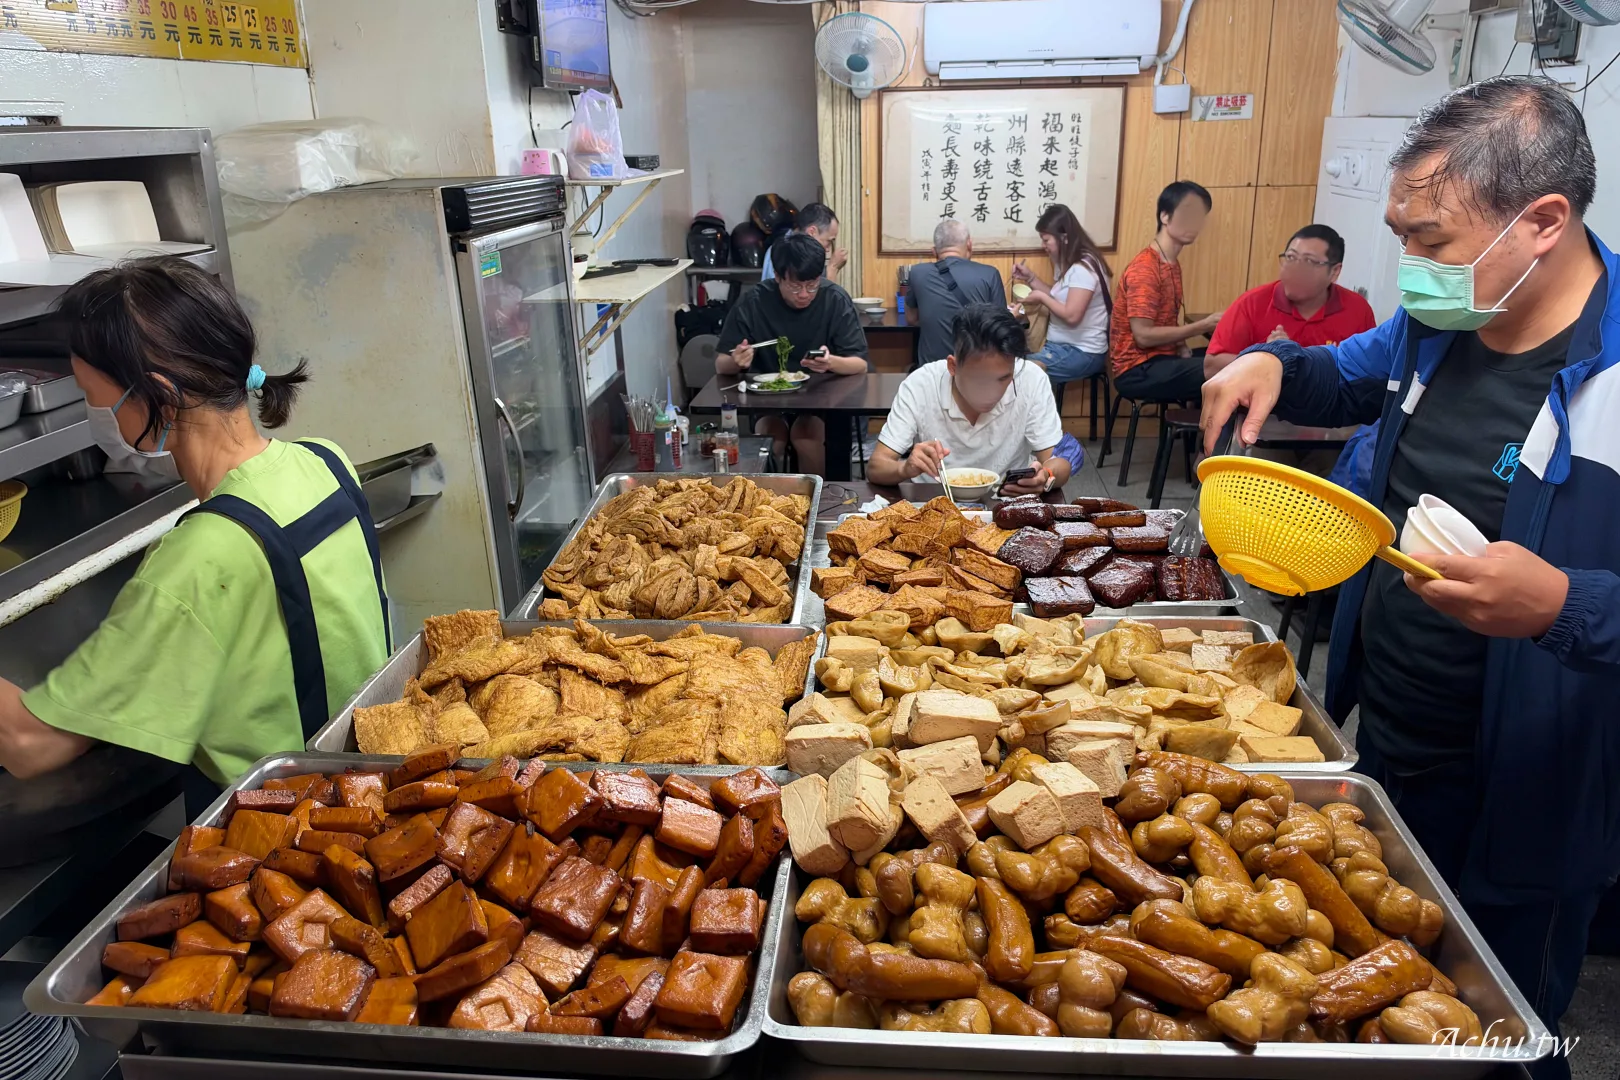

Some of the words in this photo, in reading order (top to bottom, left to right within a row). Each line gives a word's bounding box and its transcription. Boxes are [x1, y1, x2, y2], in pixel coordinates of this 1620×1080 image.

[161, 1, 177, 20] 30
[184, 5, 197, 22] 45
[205, 7, 219, 26] 35
[225, 5, 236, 23] 25
[245, 9, 257, 28] 25
[139, 21, 156, 40] 元
[164, 23, 181, 43] 元
[265, 16, 277, 32] 25
[282, 18, 294, 35] 30
[187, 26, 202, 45] 元
[209, 28, 223, 46] 元
[229, 31, 242, 48] 元
[249, 33, 262, 50] 元
[267, 35, 280, 52] 元
[284, 37, 296, 53] 元
